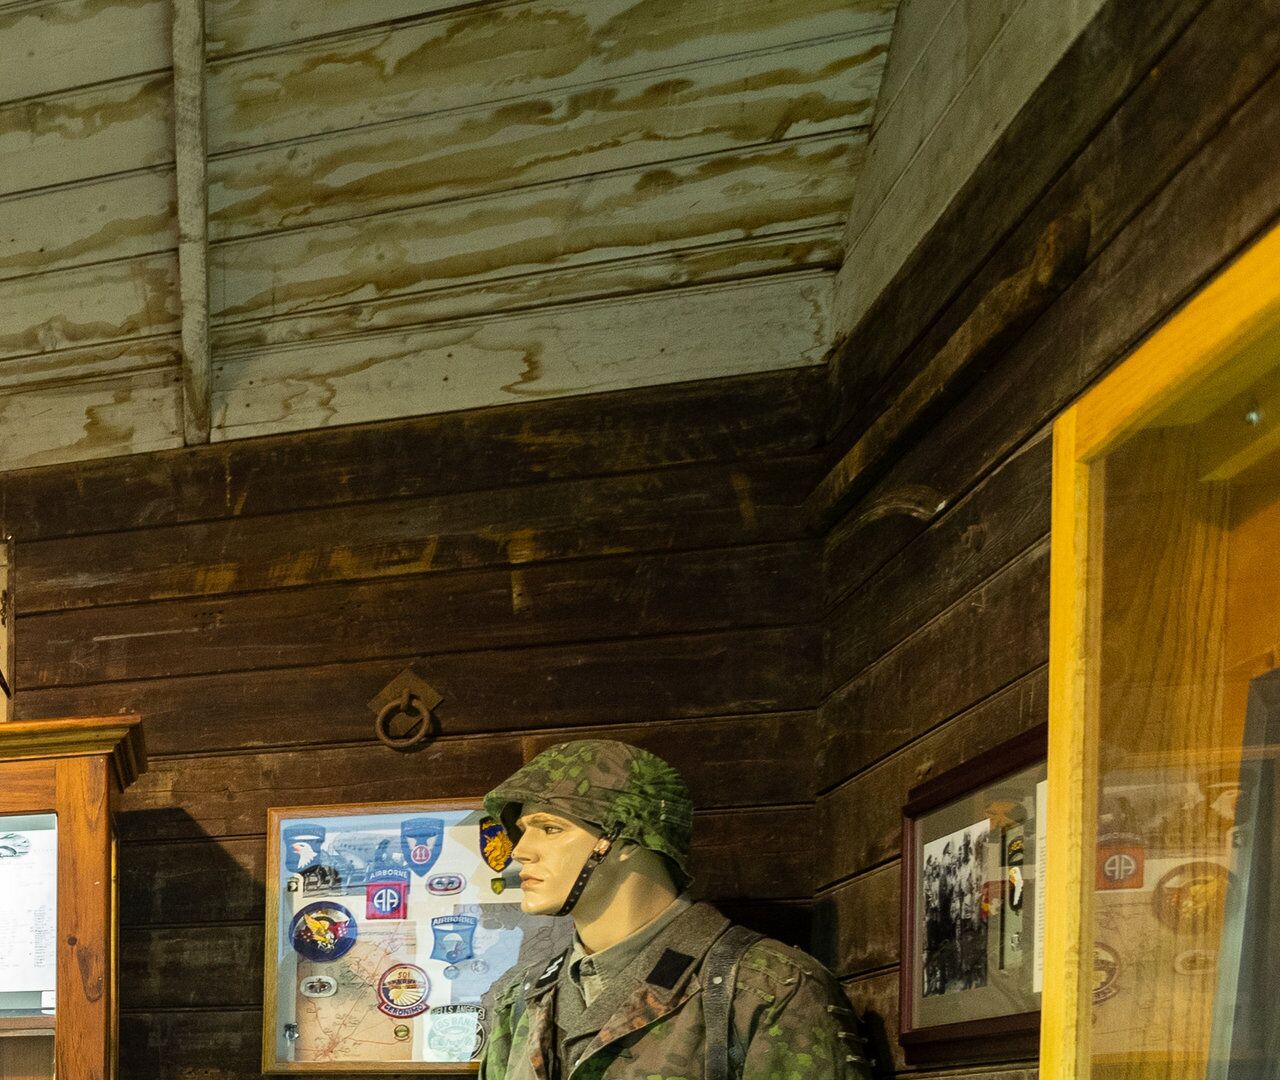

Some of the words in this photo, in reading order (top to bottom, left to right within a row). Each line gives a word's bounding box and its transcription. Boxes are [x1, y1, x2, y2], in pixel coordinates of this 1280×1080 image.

[370, 869, 408, 879] AIRBORNE
[373, 888, 400, 912] AA
[432, 916, 475, 926] AIRBORNE
[397, 971, 411, 979] 501
[384, 1003, 424, 1016] GERONIMO
